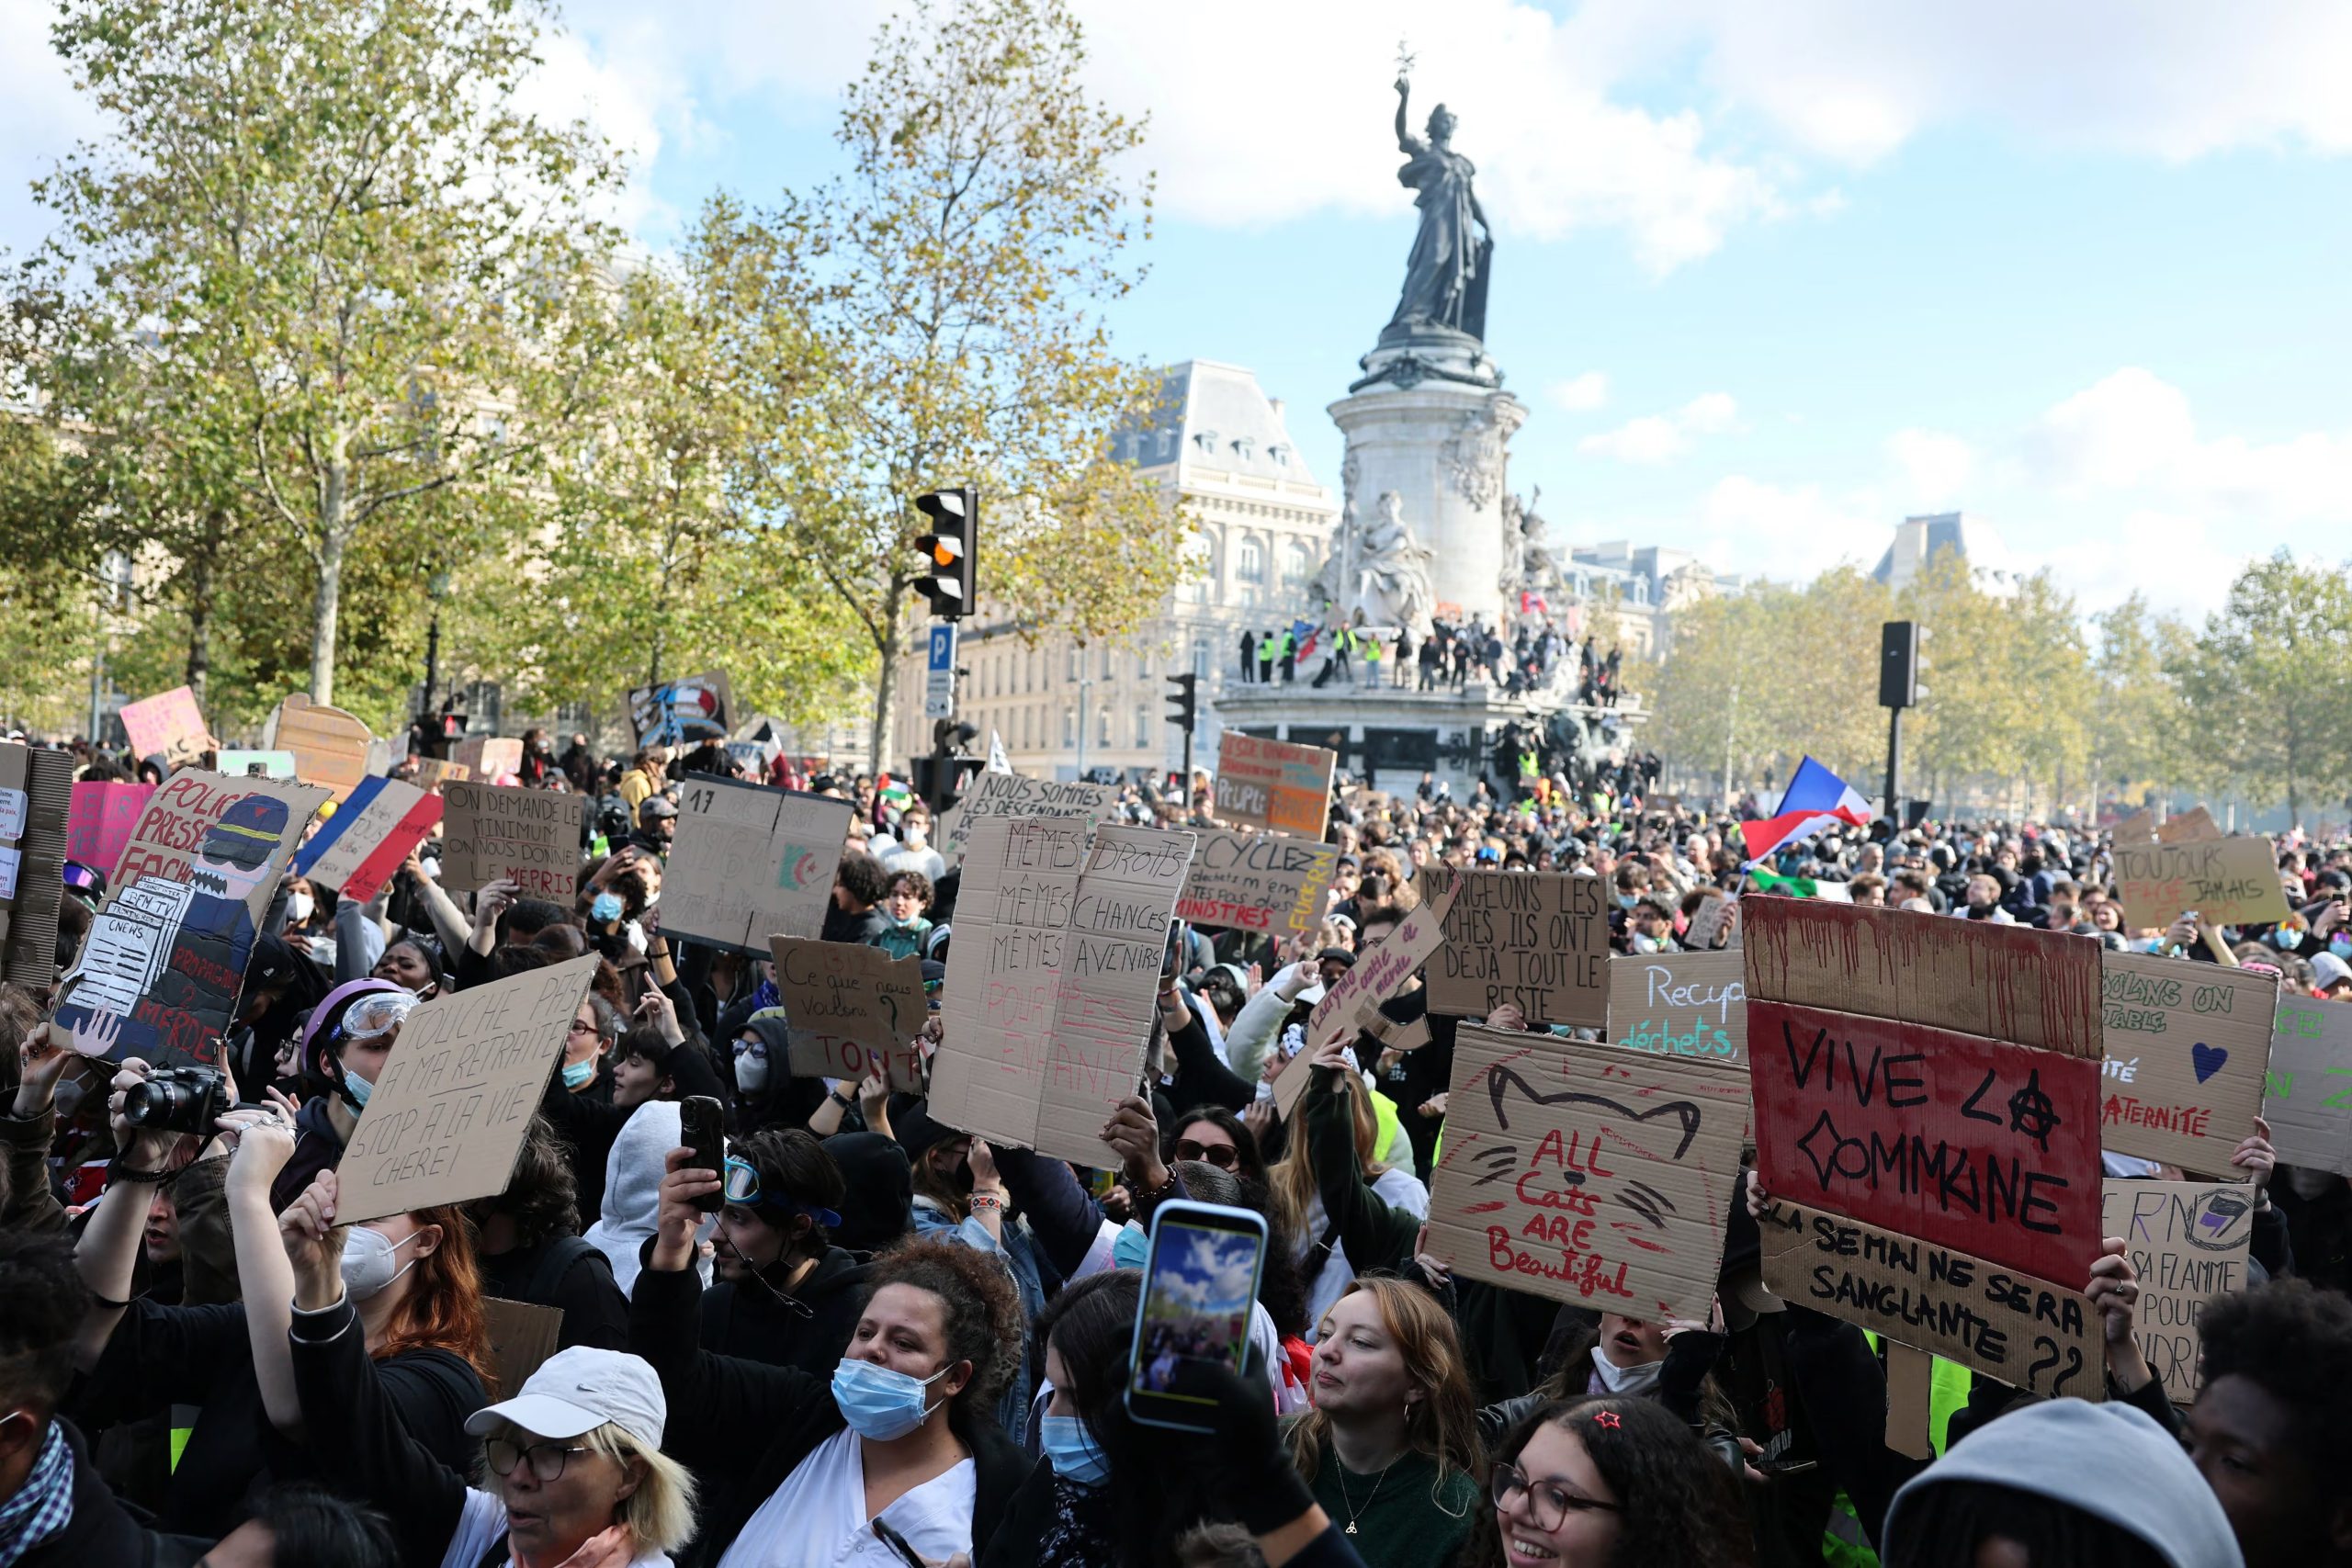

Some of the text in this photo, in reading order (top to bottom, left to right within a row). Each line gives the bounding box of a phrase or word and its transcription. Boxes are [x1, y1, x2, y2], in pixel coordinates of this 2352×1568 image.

[933, 634, 946, 664] P
[448, 786, 580, 826] ON DEMANDE LE
[689, 789, 715, 814] 17
[964, 798, 989, 816] LES
[981, 776, 1107, 807] NOUS SOMMES
[1217, 777, 1267, 815] PEUPLE
[135, 806, 218, 853] PRESSE
[448, 838, 574, 866] ON NOUS DONNE
[472, 818, 558, 843] MINIMUM
[1005, 817, 1080, 871] MÊMES
[1191, 834, 1317, 873] ECYCLEZ
[2116, 845, 2227, 882] TOUJOURS
[470, 861, 573, 895] LE MÉPRIS
[1288, 851, 1337, 931] FUCK RN
[1559, 879, 1599, 916] LES
[2187, 878, 2264, 904] JAMAIS
[125, 890, 175, 917] BFM TV
[996, 874, 1169, 933] MÊMES CHANCES
[1254, 896, 1294, 912] des
[108, 919, 143, 939] CNEWS
[1509, 912, 1538, 948] ILS
[1550, 915, 1593, 952] ONT
[991, 929, 1063, 975] MÊMES
[1445, 944, 1601, 989] DÉJÀ TOUT LE
[785, 948, 911, 1007] Ce que nous
[1645, 964, 1746, 1024] Recyc
[405, 970, 589, 1050] TOUCHE PAS
[879, 995, 899, 1042] ?
[988, 981, 1046, 1029] POUR
[1487, 985, 1555, 1021] RESTE
[2102, 1003, 2166, 1033] TABLE
[138, 998, 221, 1062] MERDE
[379, 1061, 406, 1100] A
[406, 1050, 452, 1094] MA
[816, 1035, 919, 1083] TOUT
[1001, 1030, 1135, 1104] ENFANTS
[2102, 1055, 2140, 1084] iTÉ
[1782, 1020, 2062, 1153] VIVE LA
[352, 1109, 417, 1158] STOP
[419, 1102, 447, 1145] A
[444, 1094, 482, 1139] LA
[1531, 1129, 1616, 1178] ALL
[1516, 1170, 1602, 1217] Cats
[1521, 1213, 1597, 1250] ARE
[2130, 1191, 2199, 1243] RN
[1486, 1224, 1635, 1299] Beautiful
[1766, 1201, 1804, 1234] LA
[1984, 1273, 2084, 1338] SERA
[2132, 1250, 2241, 1294] SA FLAMME
[1809, 1265, 2084, 1401] SANGLANTE ??
